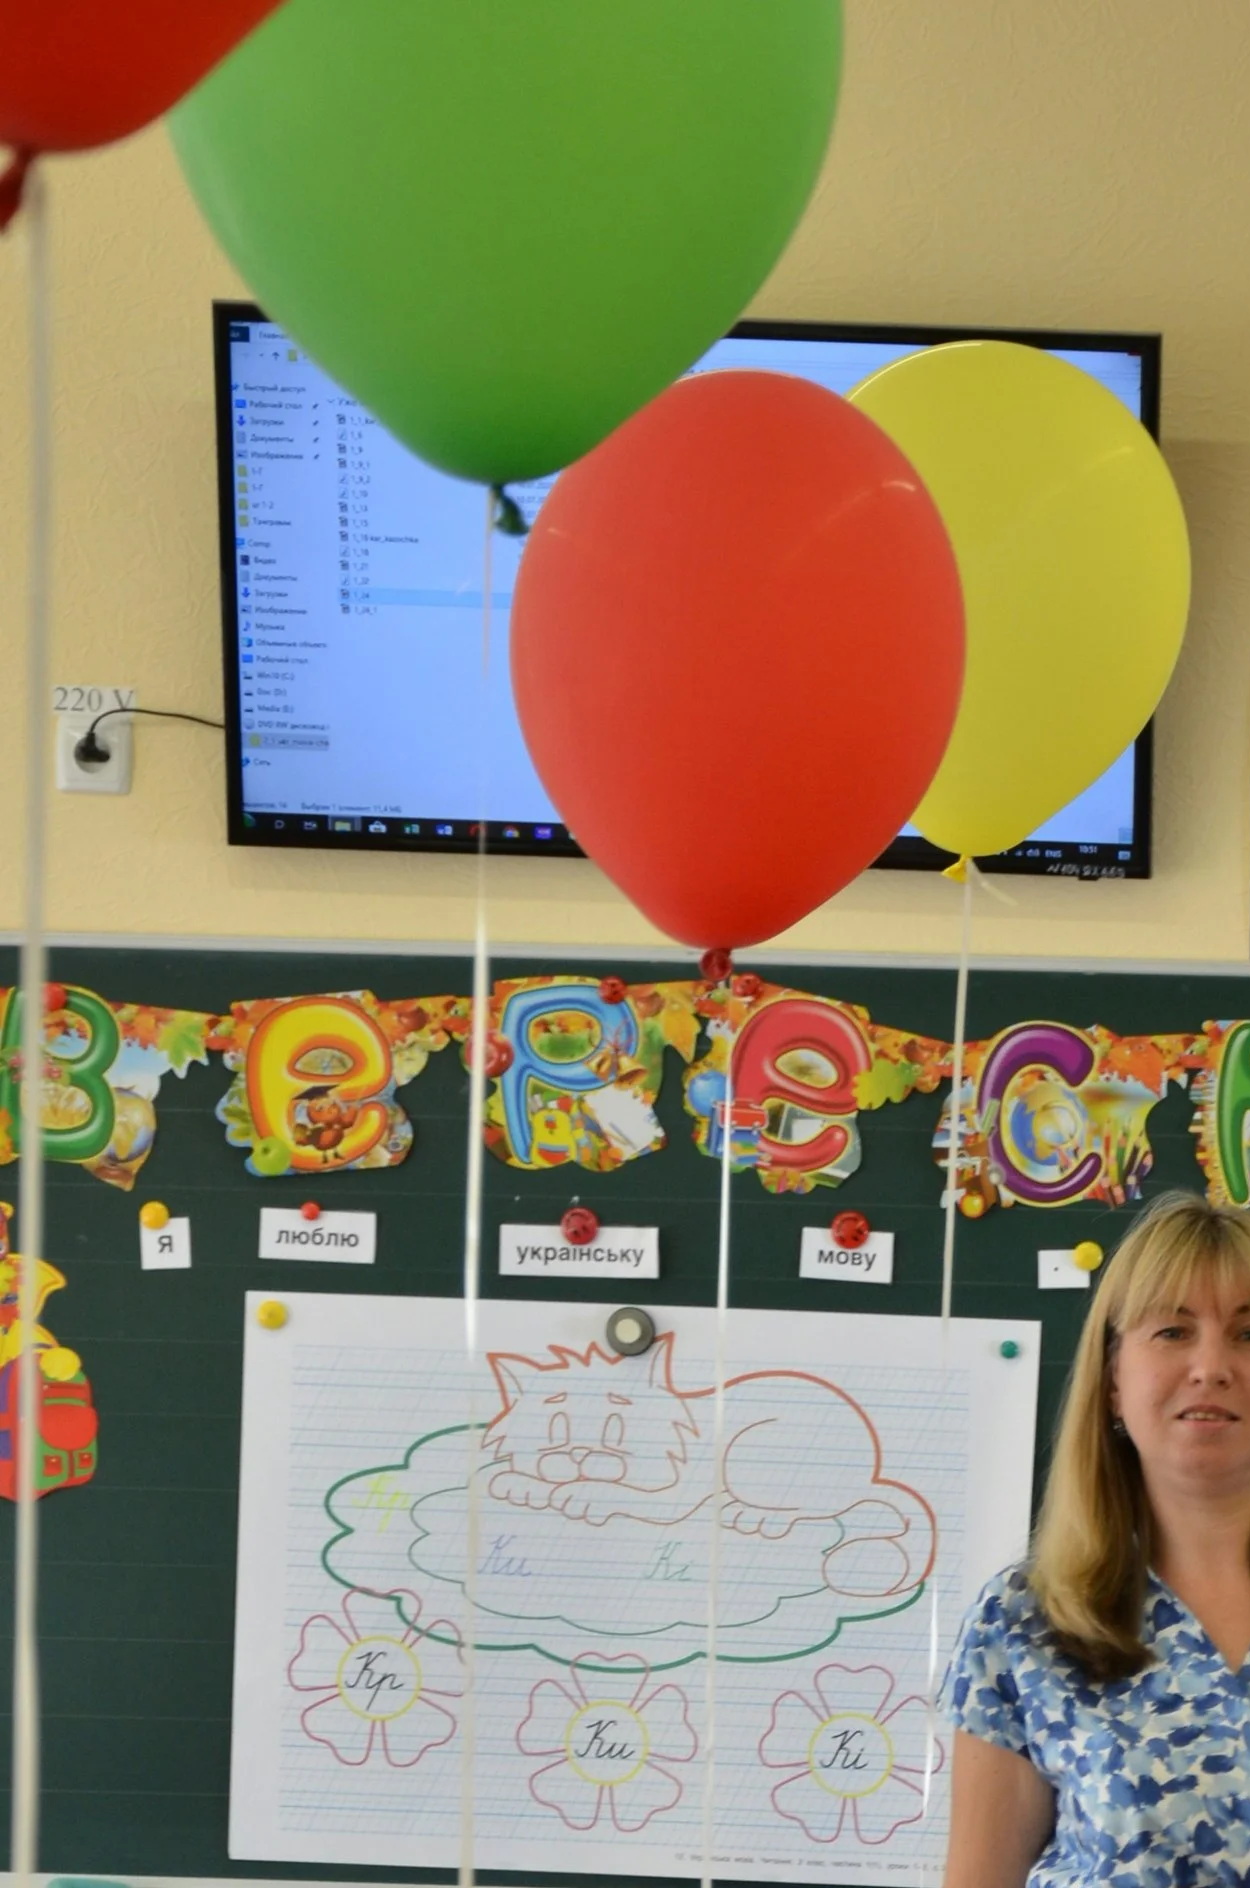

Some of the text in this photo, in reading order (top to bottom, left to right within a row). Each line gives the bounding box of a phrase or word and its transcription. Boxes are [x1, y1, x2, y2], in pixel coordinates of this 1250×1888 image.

[53, 686, 135, 712] 220 V
[275, 1226, 360, 1251] люблю
[817, 1247, 878, 1273] мову
[344, 1651, 404, 1711] Кр
[574, 1719, 634, 1760] Ки
[819, 1729, 870, 1771] Кі
